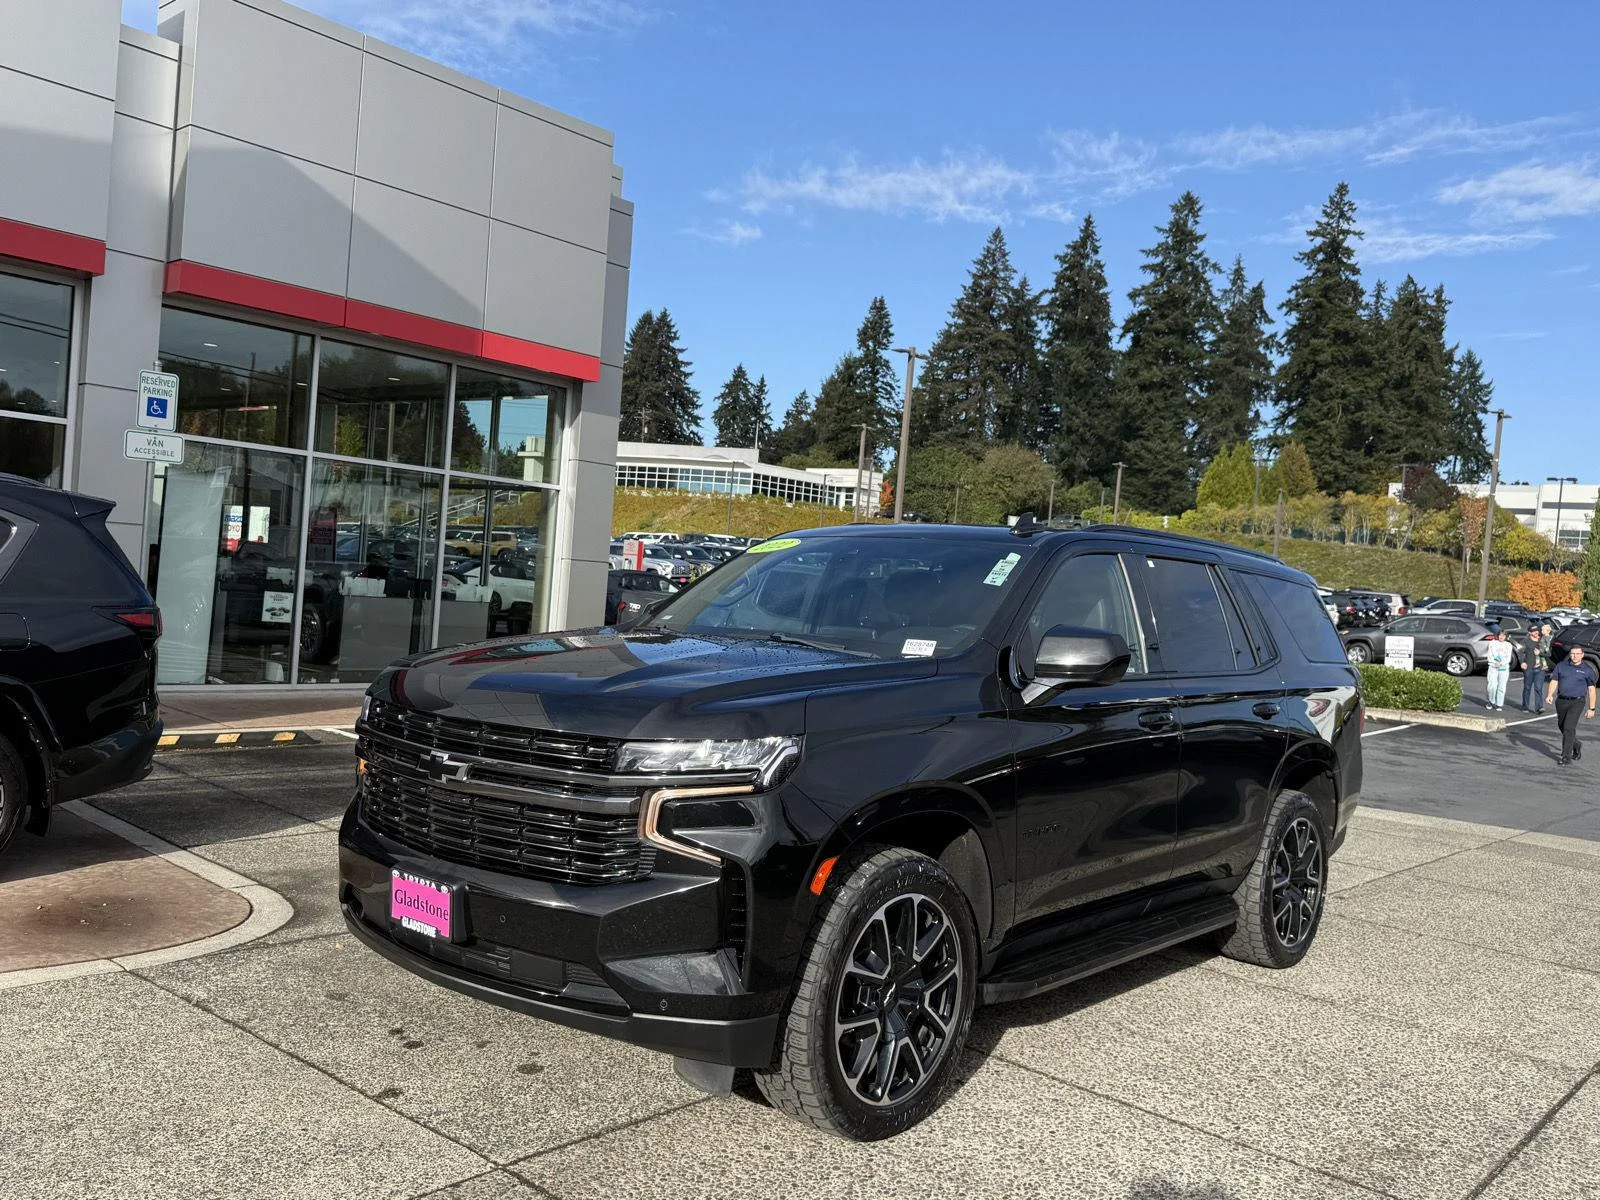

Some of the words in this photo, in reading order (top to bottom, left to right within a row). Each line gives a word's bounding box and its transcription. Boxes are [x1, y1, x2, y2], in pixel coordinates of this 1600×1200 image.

[141, 375, 176, 389] RESERVED
[143, 386, 173, 398] PARKING
[146, 438, 164, 448] VAN
[133, 447, 175, 458] ACCESSIBLE
[223, 524, 242, 533] TOYO
[403, 873, 437, 890] TOYOTA
[394, 889, 449, 921] Gladstone
[401, 916, 437, 938] GLADSTONE
